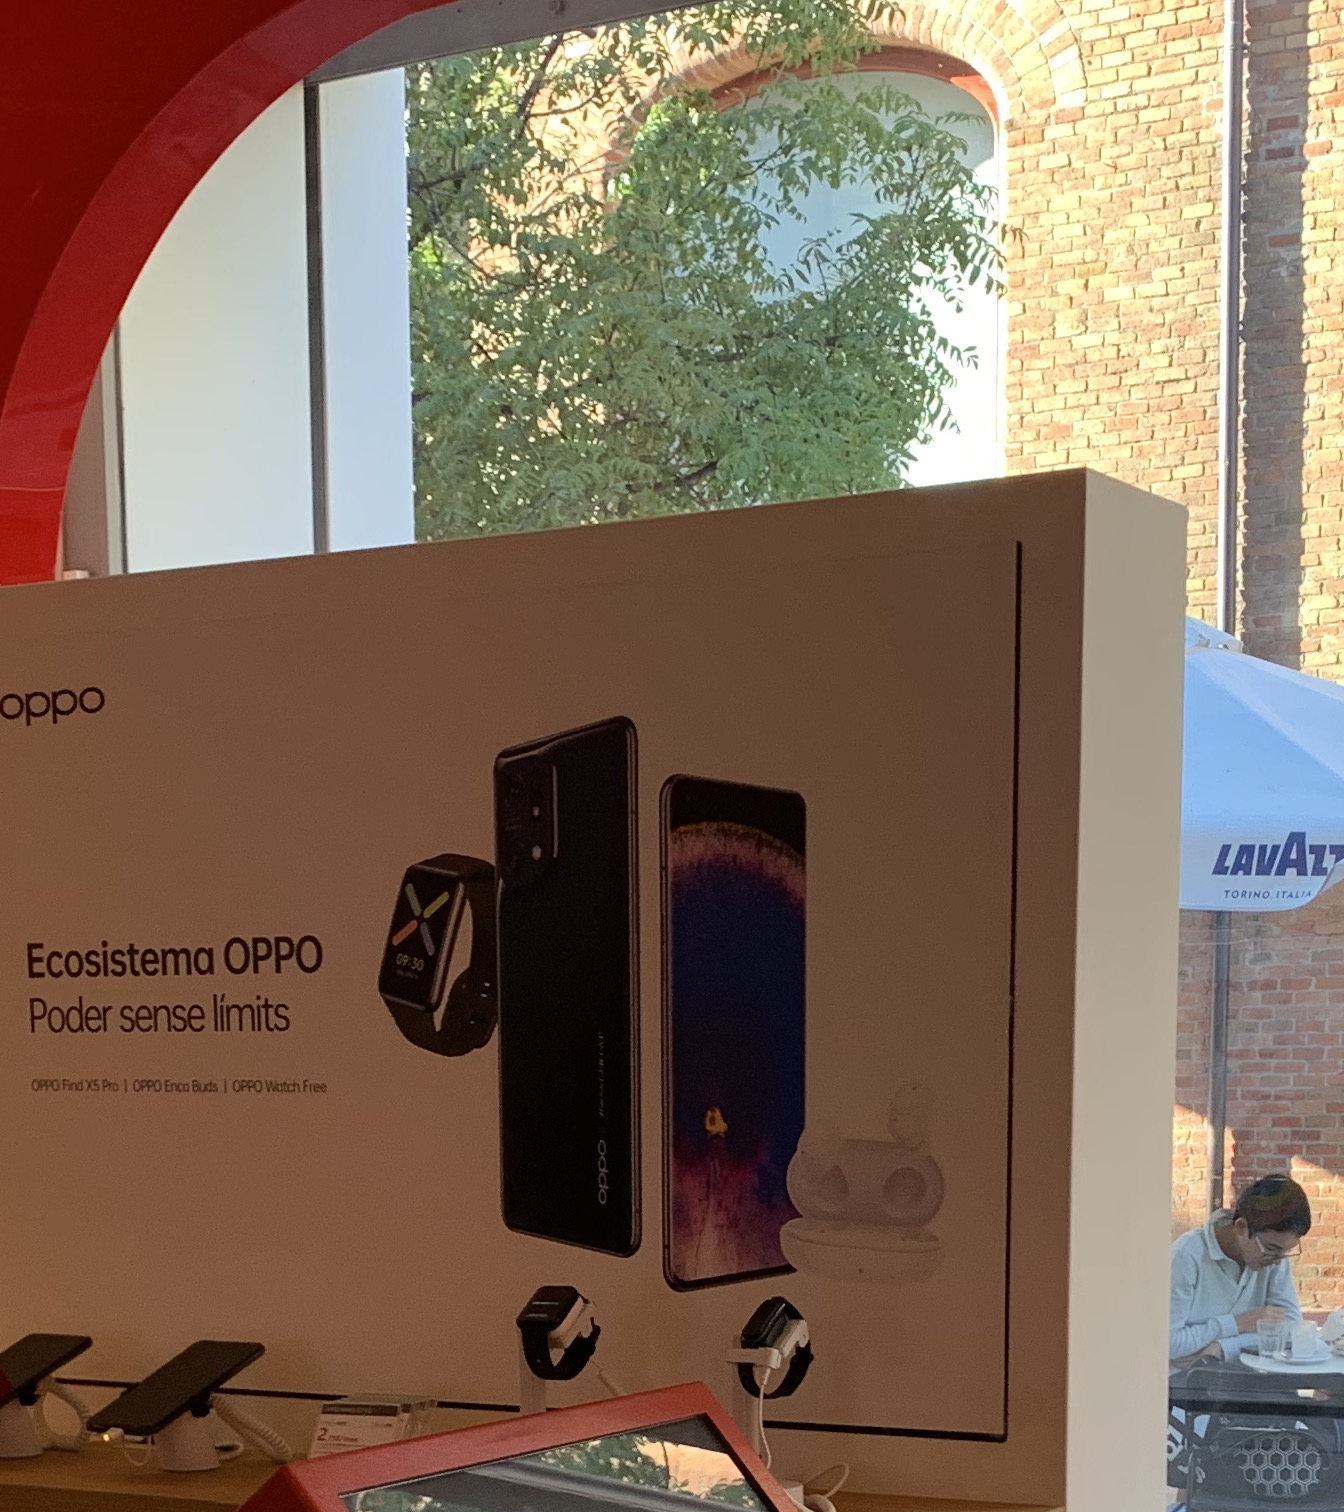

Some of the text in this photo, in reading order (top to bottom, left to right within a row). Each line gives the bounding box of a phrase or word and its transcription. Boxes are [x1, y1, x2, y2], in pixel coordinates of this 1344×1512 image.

[1276, 889, 1313, 899] ITALIA
[27, 935, 324, 980] Ecosistema OPPO
[29, 993, 291, 1034] Poder sense límits
[31, 1079, 58, 1093] OPPO
[62, 1079, 84, 1093] Find
[102, 1080, 119, 1093] Pro
[133, 1080, 162, 1093] OPPO
[164, 1080, 189, 1093] Enco
[192, 1079, 218, 1093] Buds
[232, 1080, 262, 1093] OPPO
[265, 1079, 300, 1093] Watch
[303, 1080, 327, 1093] Free
